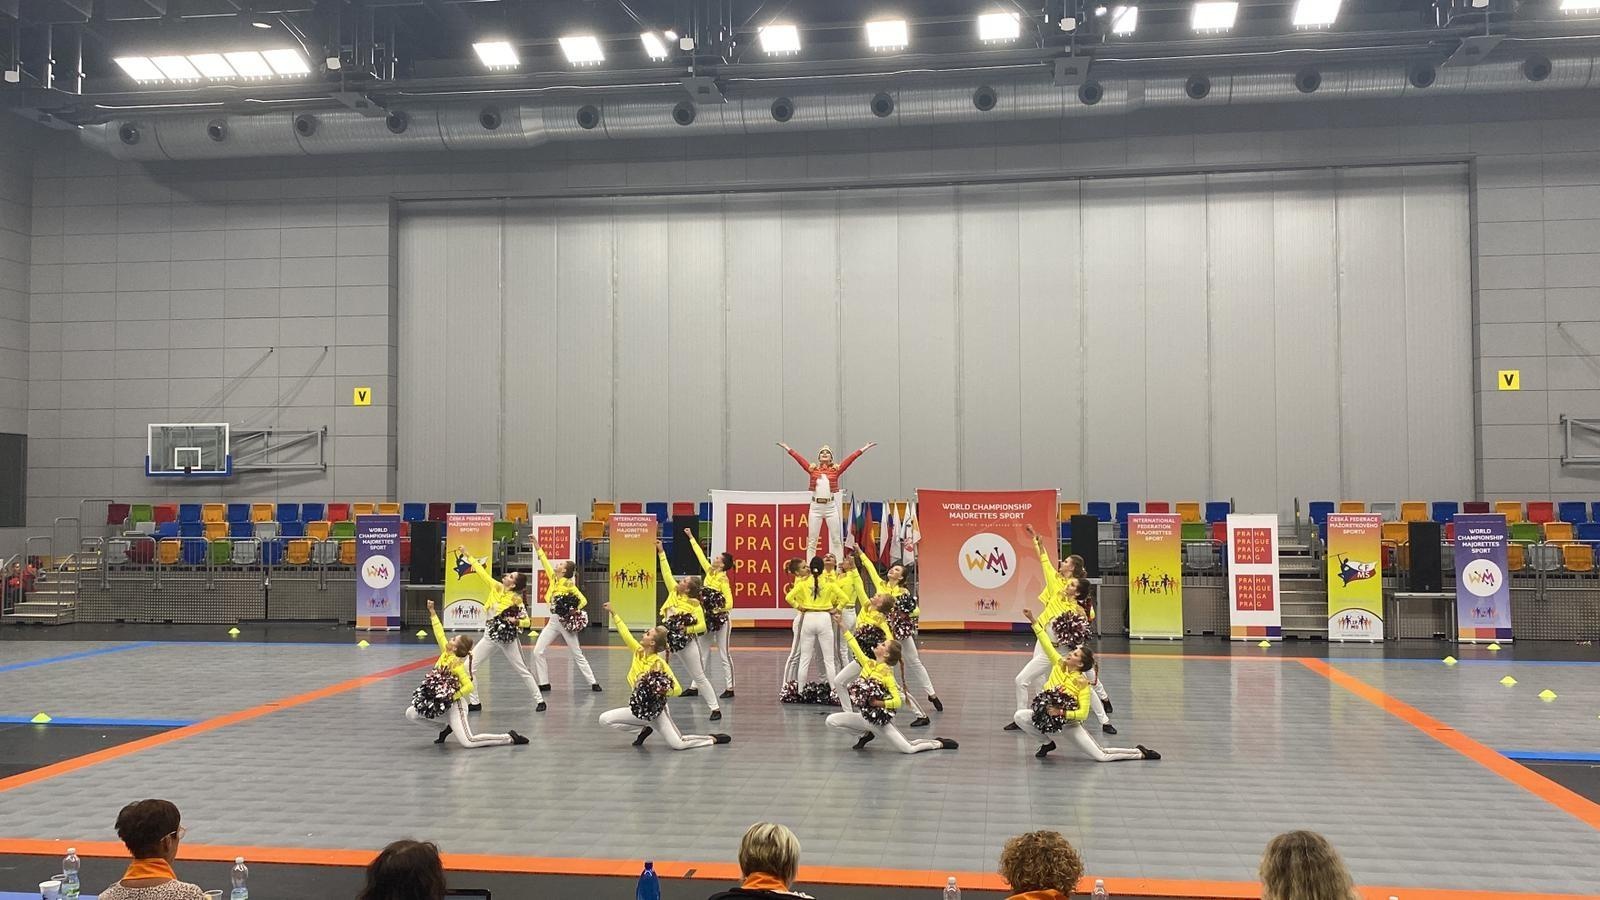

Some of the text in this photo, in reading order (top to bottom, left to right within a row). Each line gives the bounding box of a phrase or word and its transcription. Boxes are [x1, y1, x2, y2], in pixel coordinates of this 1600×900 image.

[1504, 374, 1514, 386] V
[358, 391, 367, 402] V
[972, 503, 1032, 511] CHAMPIONSHIP
[735, 513, 809, 528] PRA HA
[949, 512, 998, 520] MAJORETTES
[735, 536, 771, 551] PRA
[735, 559, 771, 574] PRA
[735, 582, 771, 596] PRA
